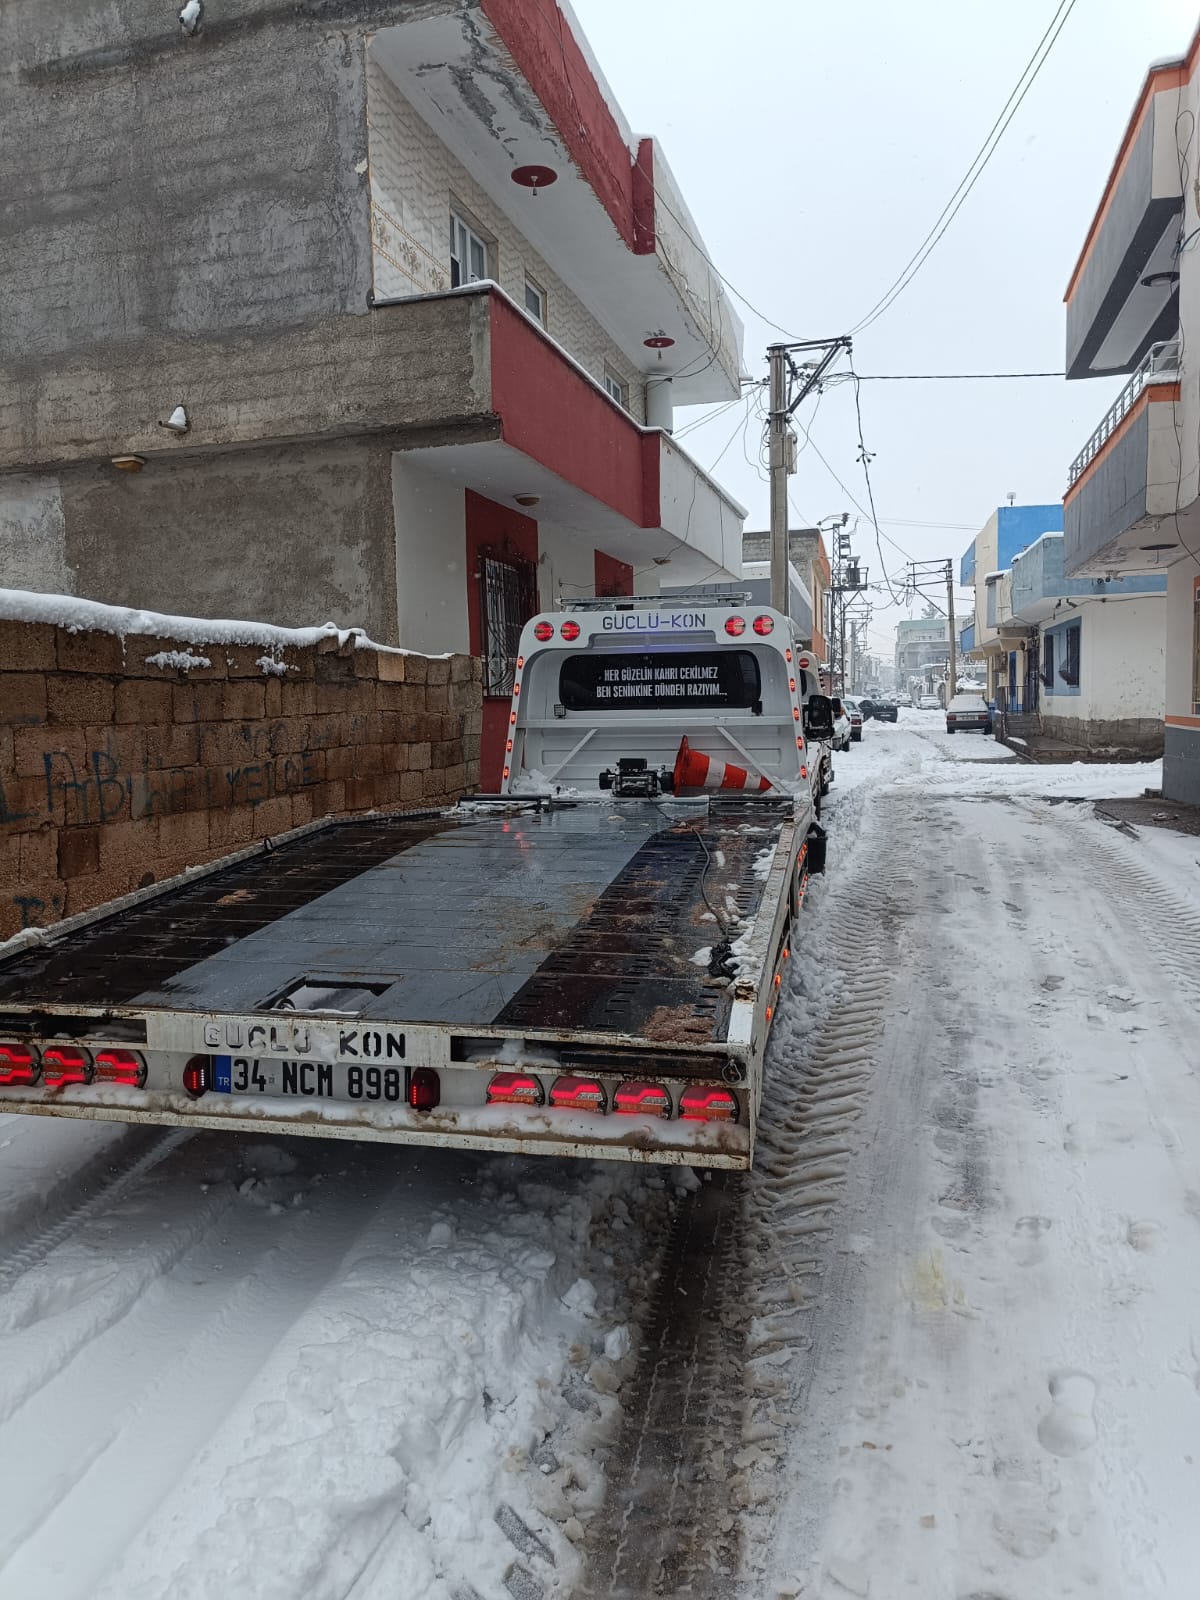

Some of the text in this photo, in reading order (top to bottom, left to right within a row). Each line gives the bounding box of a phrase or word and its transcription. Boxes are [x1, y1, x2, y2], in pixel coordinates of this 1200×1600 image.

[604, 669, 620, 681] HER
[621, 666, 653, 681] GÜZELİN
[654, 667, 678, 680] KAHRI
[596, 685, 612, 698] BEN
[613, 683, 653, 697] SENİNKİNE
[655, 682, 685, 697] DÜNDEN
[339, 1030, 406, 1058] KON
[217, 1058, 400, 1101] TR 34 NCM 898
